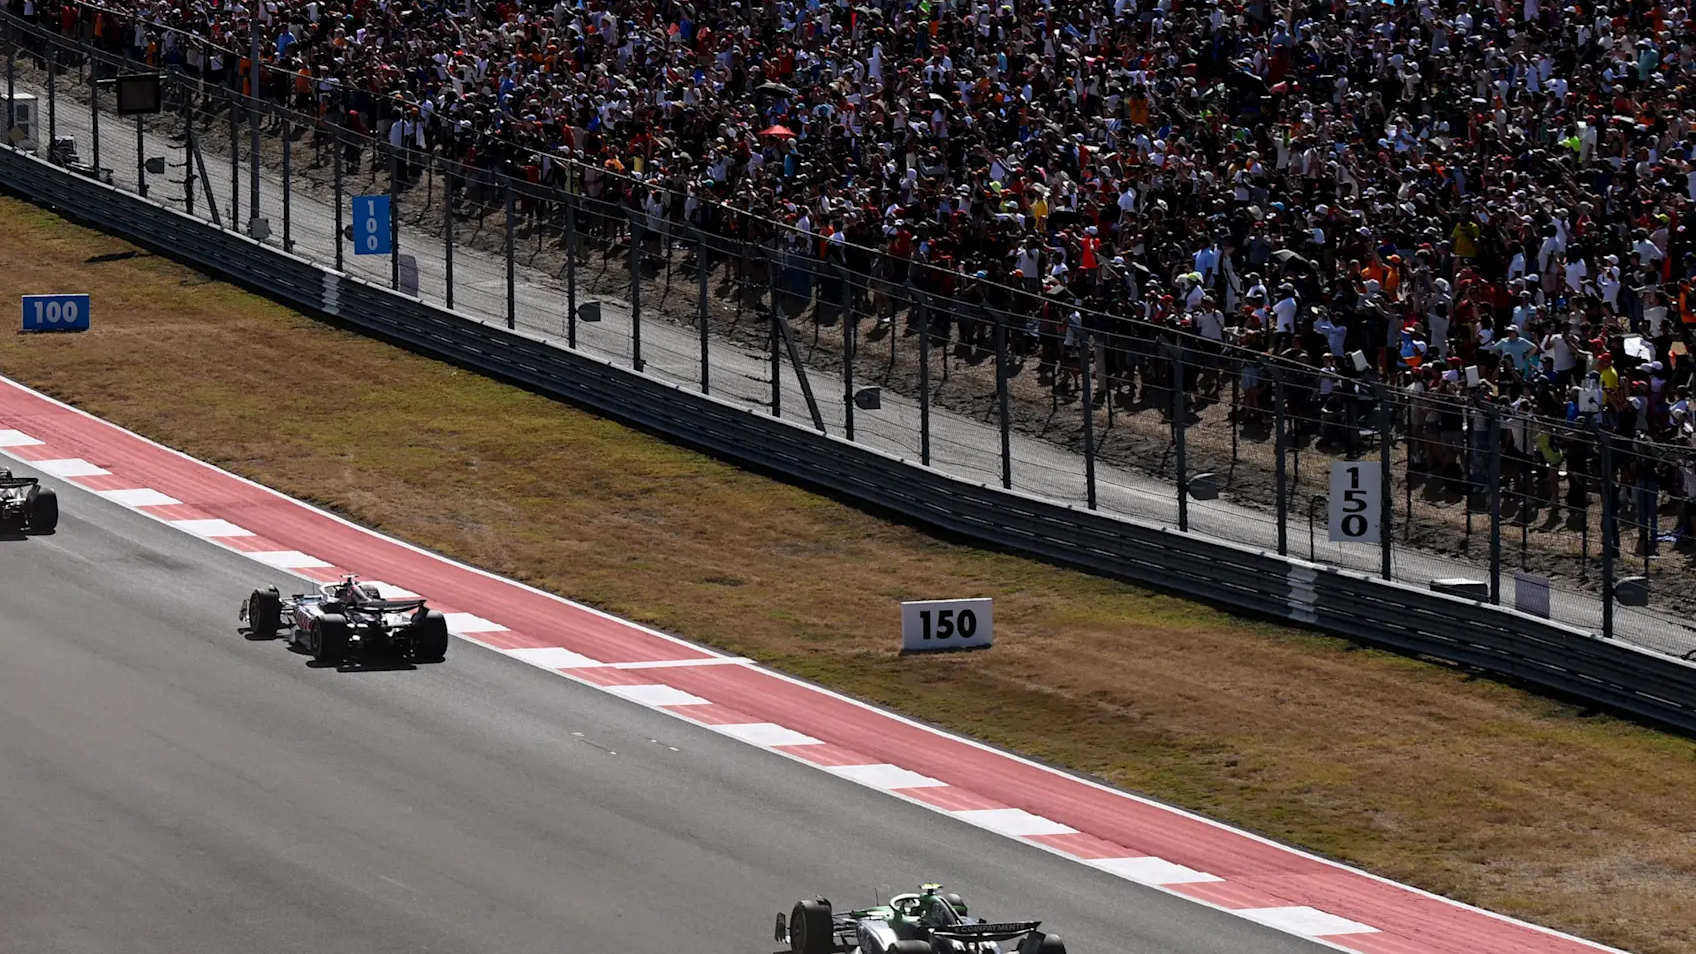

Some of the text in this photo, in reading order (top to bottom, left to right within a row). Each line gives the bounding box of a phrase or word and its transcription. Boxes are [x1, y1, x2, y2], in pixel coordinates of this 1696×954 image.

[365, 199, 379, 251] 100
[34, 301, 78, 323] 100
[1341, 467, 1368, 537] 150
[919, 609, 977, 640] 150
[960, 923, 1024, 933] COINPAYMENTS
